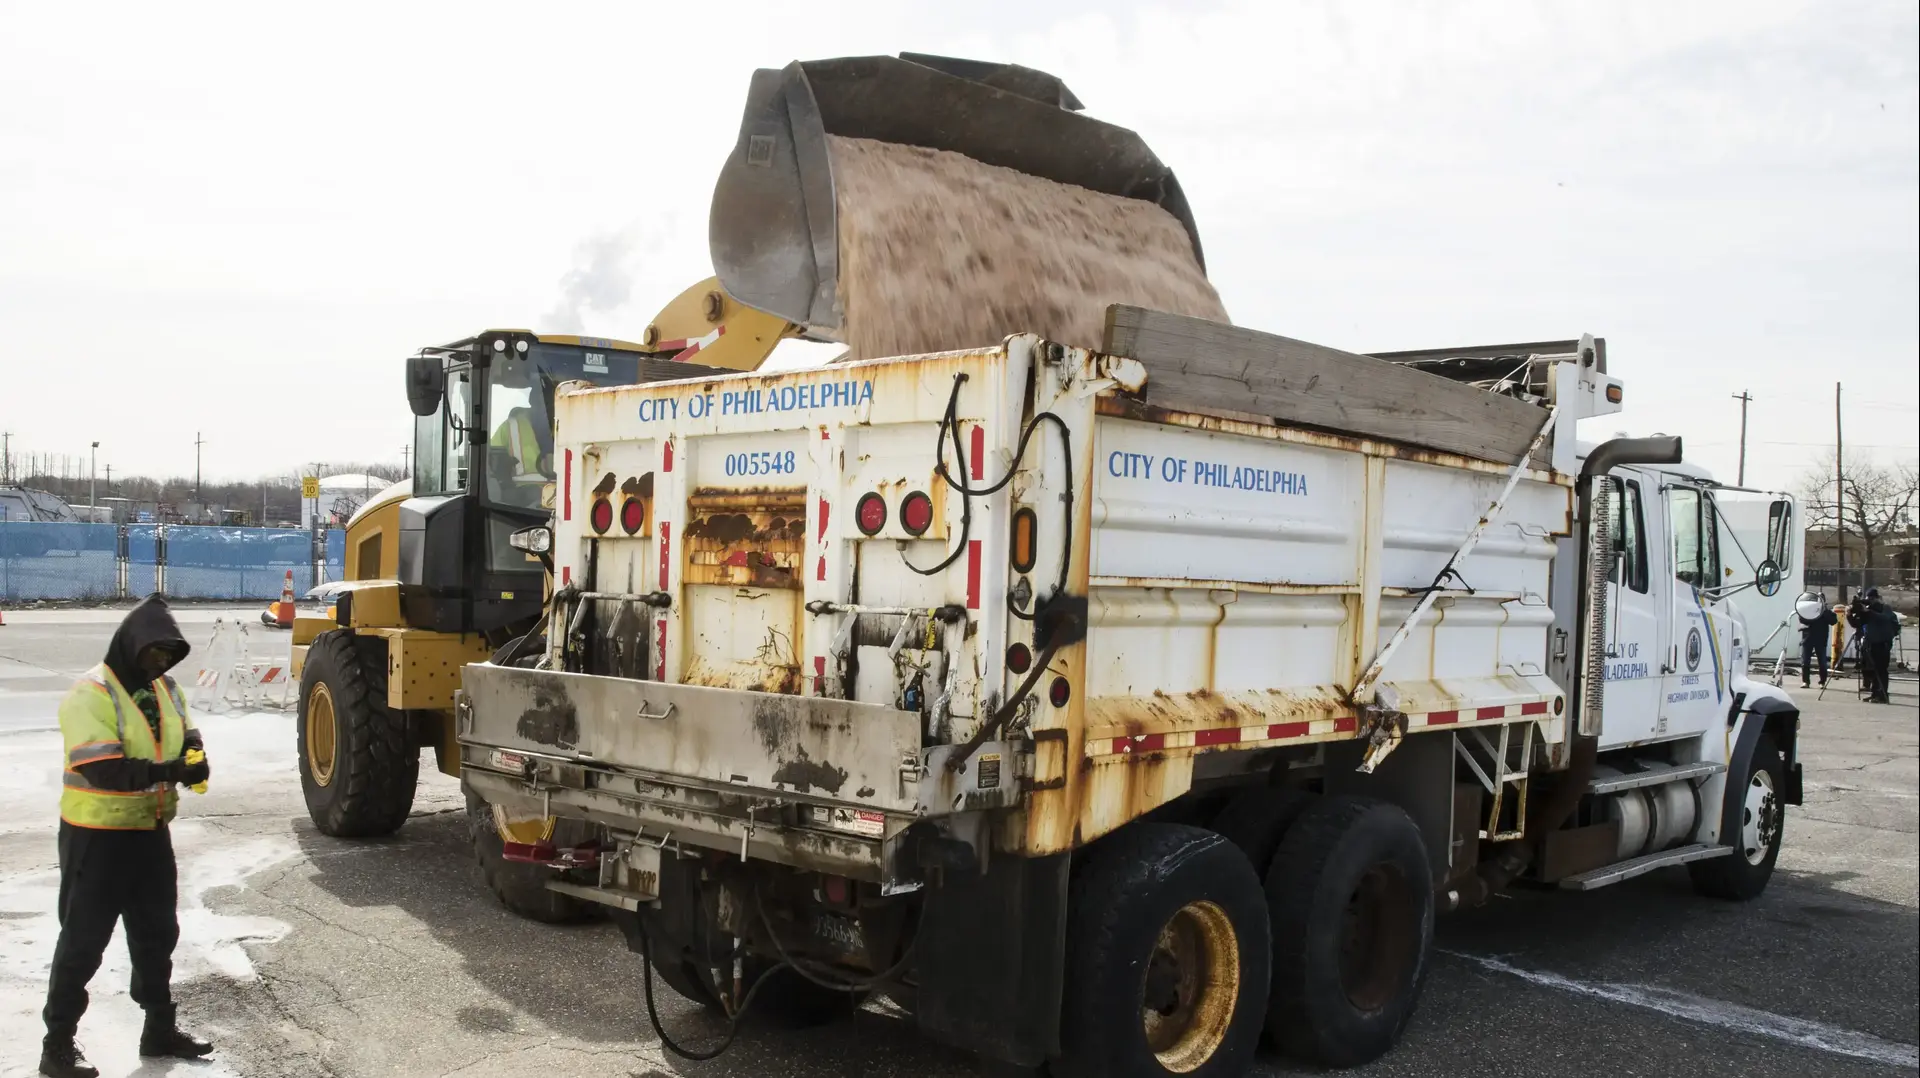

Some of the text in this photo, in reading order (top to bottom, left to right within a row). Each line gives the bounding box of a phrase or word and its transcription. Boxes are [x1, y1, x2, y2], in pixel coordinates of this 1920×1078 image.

[585, 352, 605, 366] CAT
[638, 379, 873, 422] CITY OF PHILADELPHIA
[725, 450, 795, 477] 005548
[1108, 450, 1308, 496] CITY OF PHILADELPHIA
[306, 485, 316, 494] 10
[1628, 642, 1639, 659] OF
[861, 811, 884, 822] DANGER
